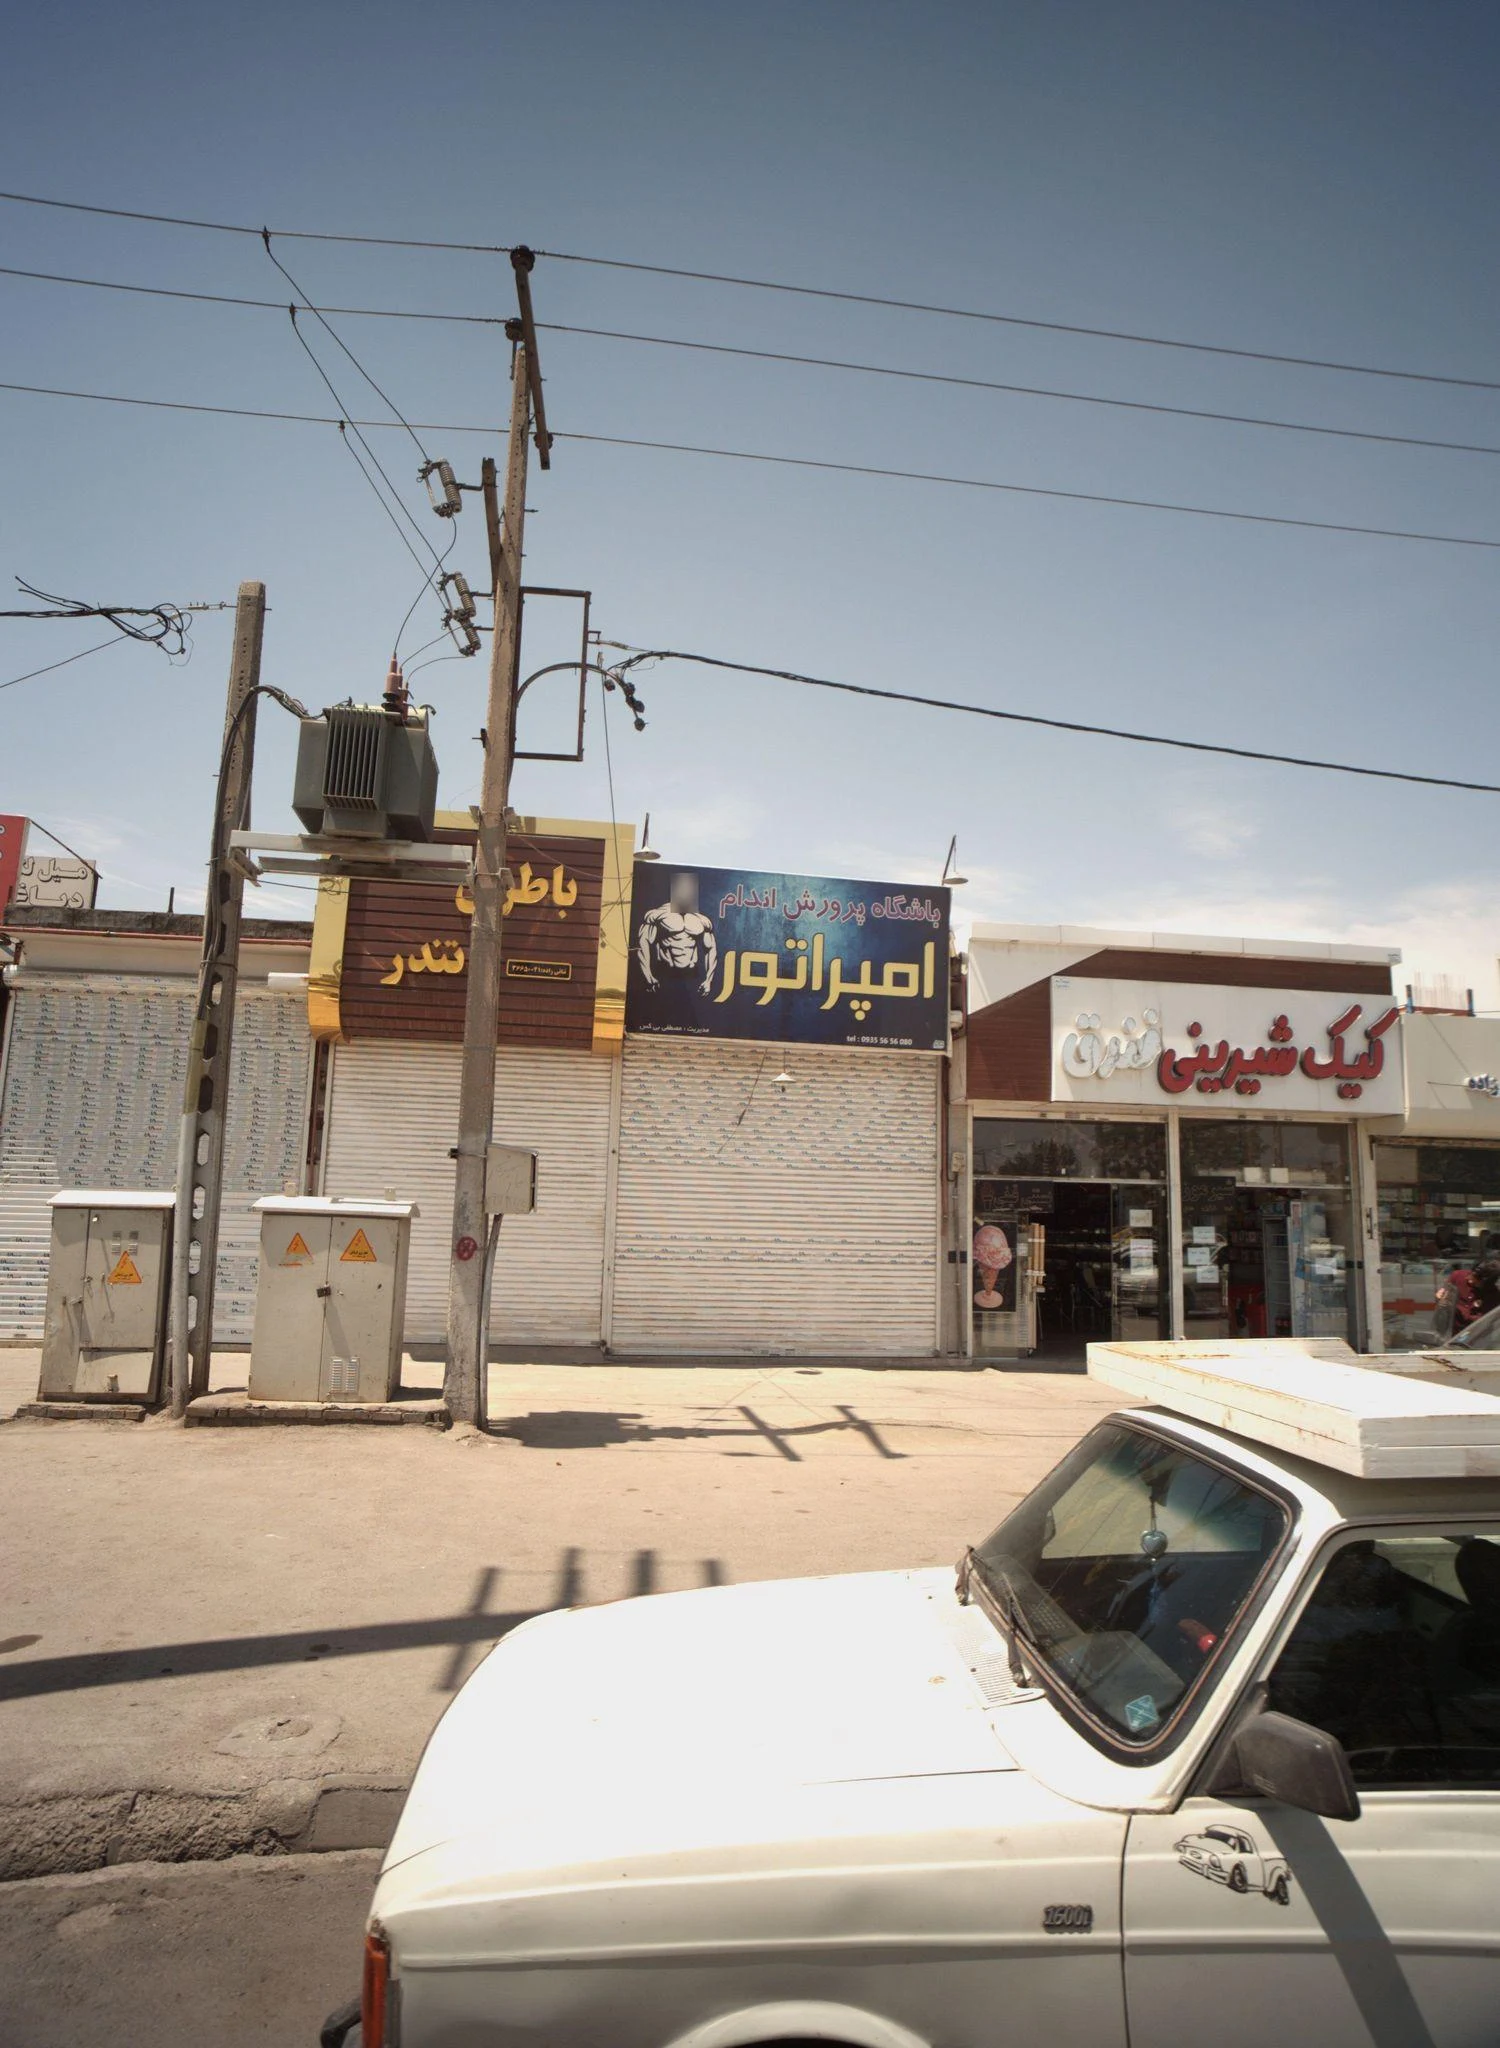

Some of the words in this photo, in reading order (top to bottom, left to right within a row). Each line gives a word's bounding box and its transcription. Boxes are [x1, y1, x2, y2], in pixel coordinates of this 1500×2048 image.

[719, 884, 777, 917] اندام
[783, 889, 866, 926] پرورش
[872, 894, 941, 928] باشگاه
[380, 938, 465, 985] تندر
[714, 932, 935, 1021] امپراتور
[879, 1037, 888, 1045] 56
[889, 1037, 898, 1045] 56
[1061, 1007, 1163, 1080] فندق
[1158, 1014, 1299, 1095] شیرینی
[1300, 1003, 1400, 1100] کیک
